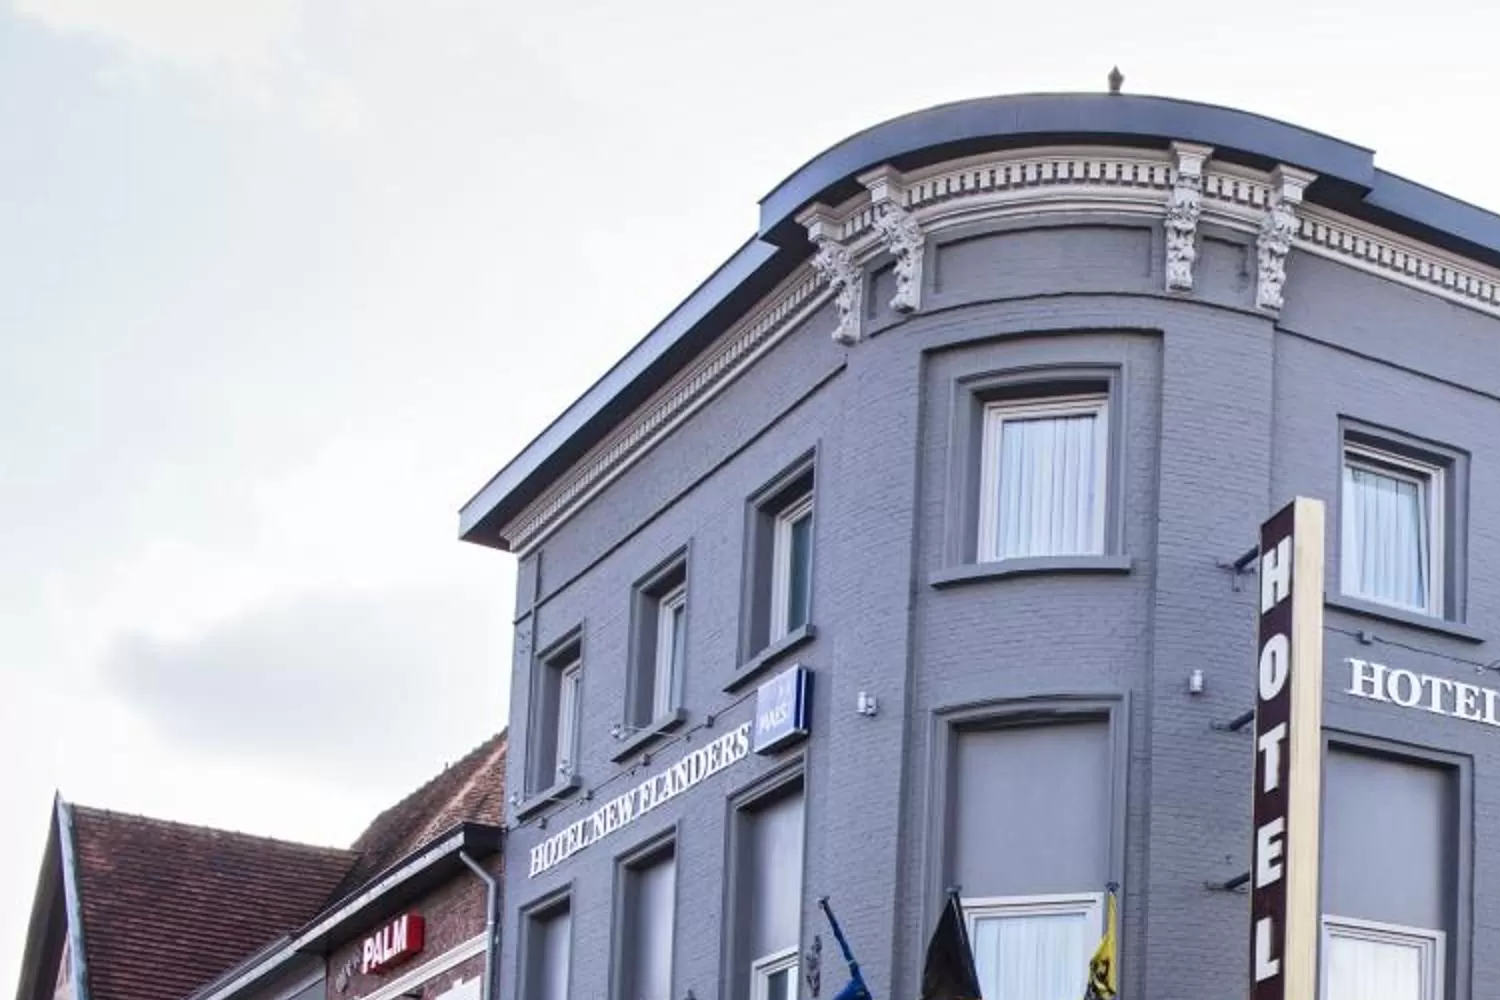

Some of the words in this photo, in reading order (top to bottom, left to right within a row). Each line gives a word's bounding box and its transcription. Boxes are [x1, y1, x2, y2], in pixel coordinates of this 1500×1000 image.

[527, 818, 592, 879] HOTEL
[591, 787, 637, 843] NEW
[636, 719, 753, 817] FLANDERS
[1253, 534, 1292, 984] HOTEL
[361, 913, 409, 975] PALM
